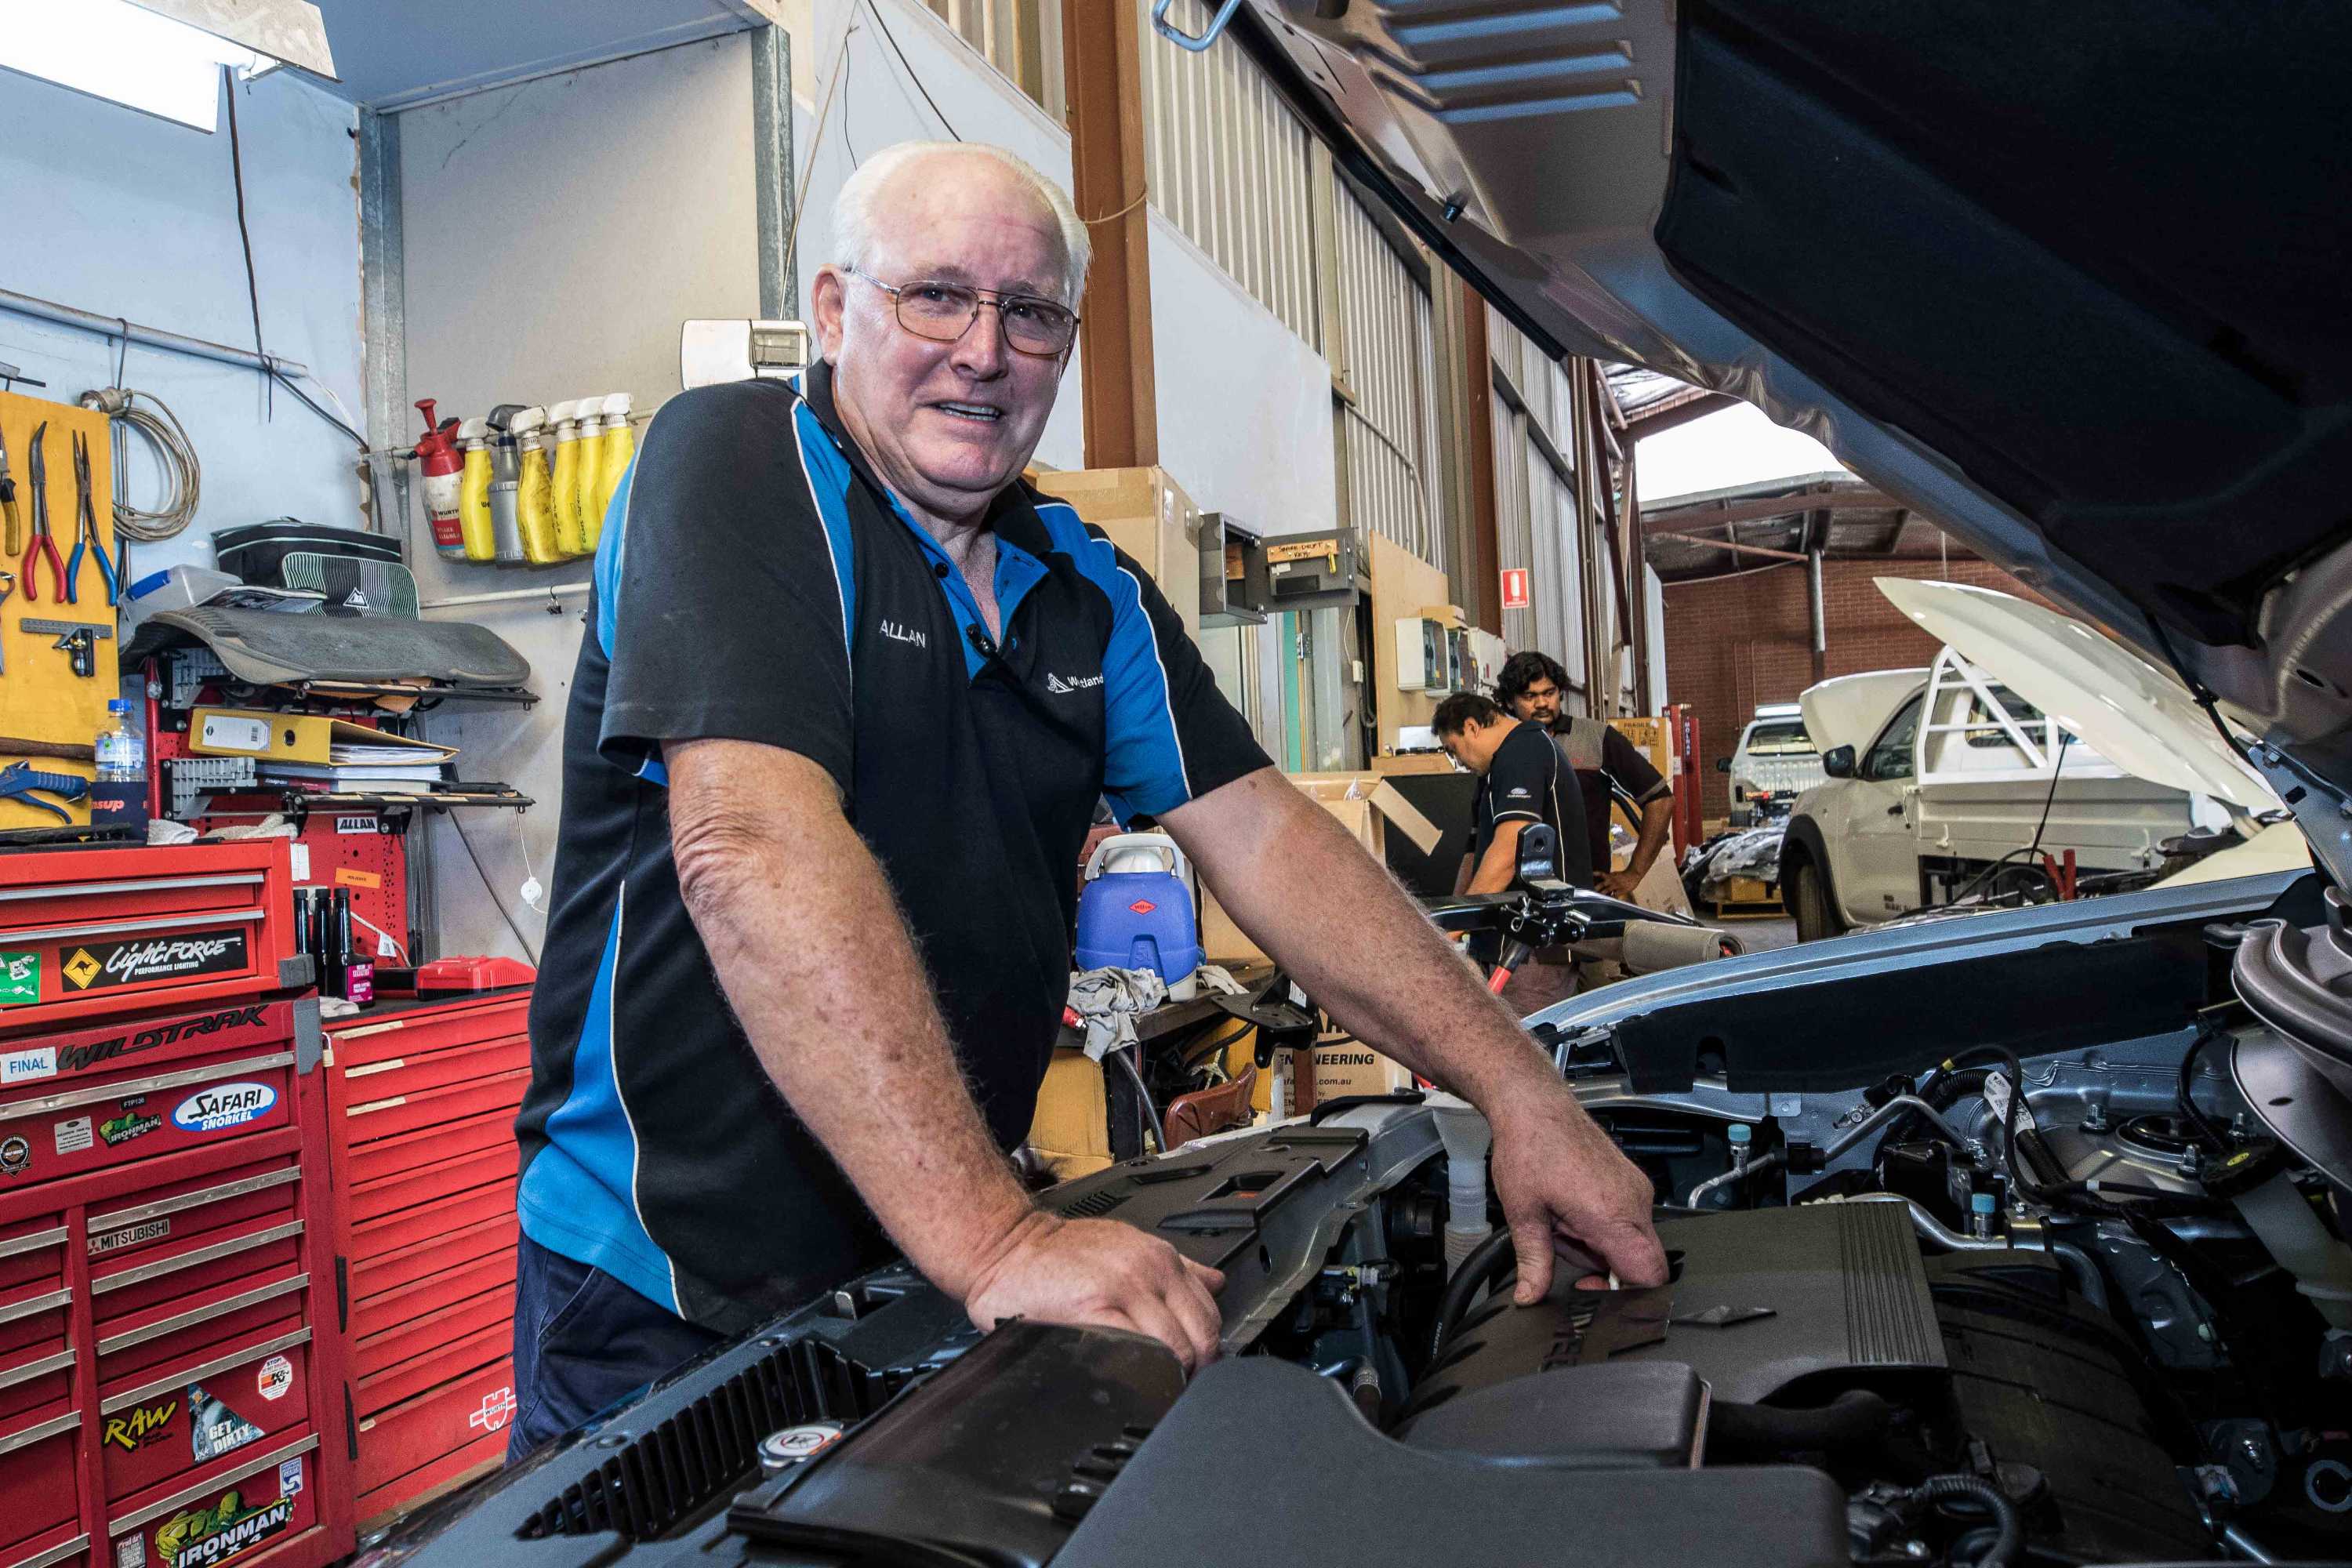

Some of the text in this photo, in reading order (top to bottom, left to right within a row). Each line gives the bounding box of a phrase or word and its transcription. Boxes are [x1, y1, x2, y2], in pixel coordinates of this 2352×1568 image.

[879, 619, 926, 648] ALLAN
[339, 818, 376, 830] ALLAN
[134, 960, 199, 975] PERFORMANCE LIGHTING
[56, 1004, 270, 1071] WILDTRAK
[9, 1057, 49, 1074] FINAL
[188, 1089, 262, 1120] SAFARI
[111, 1117, 160, 1142] IRONMAN
[201, 1111, 253, 1131] SNORKEL
[100, 1221, 169, 1250] MITSUBISHI
[104, 1401, 176, 1450] RAW
[209, 1418, 232, 1441] GET
[212, 1423, 250, 1454] DIRTY
[179, 1504, 286, 1568] IRONMAN
